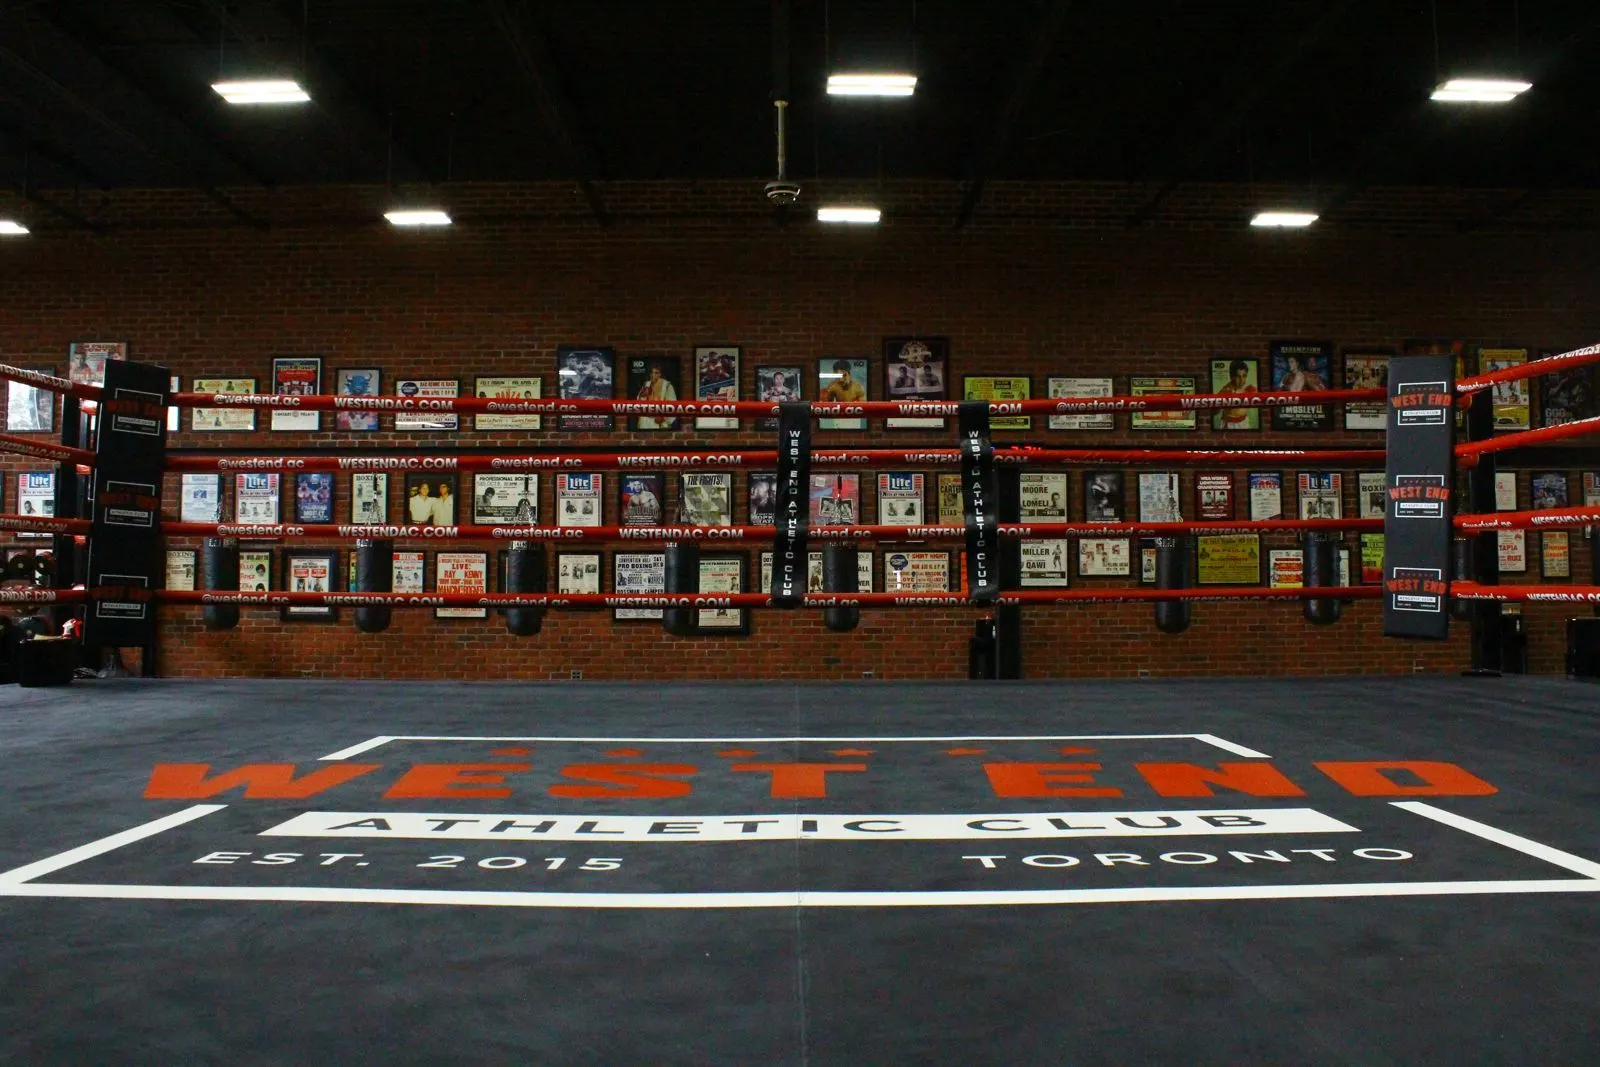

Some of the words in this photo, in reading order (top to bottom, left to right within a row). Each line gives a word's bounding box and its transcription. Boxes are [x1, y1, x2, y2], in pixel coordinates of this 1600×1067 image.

[214, 394, 300, 407] @westend.ac
[334, 397, 454, 410] WESTENDAC.COM
[487, 401, 577, 412] @westend.ac
[612, 403, 736, 415] WESTENDAC.COM
[1056, 401, 1146, 412] @westend.ac
[1181, 397, 1300, 409] WESTENDAC.COM
[1390, 393, 1425, 408] WEST
[1427, 393, 1453, 408] END
[789, 430, 801, 464] WEST
[968, 429, 981, 461] WEST
[217, 458, 305, 470] @westend.ac
[338, 457, 457, 469] WESTENDAC.COM
[491, 457, 583, 469] @westend.ac
[617, 455, 742, 467] WESTENDAC.COM
[569, 477, 589, 489] Lite
[687, 475, 699, 486] THE
[699, 475, 724, 486] FIGHTS!
[789, 470, 798, 495] END
[891, 478, 911, 489] Lite
[1022, 486, 1048, 494] MOORE
[1388, 486, 1422, 500] WEST
[1425, 486, 1451, 501] END
[1022, 500, 1049, 508] LOMELI
[972, 481, 987, 548] ATHLETIC
[216, 524, 305, 537] @westend.ac
[338, 524, 458, 538] WESTENDAC.COM
[492, 525, 584, 539] @westend.ac
[619, 526, 744, 540] WESTENDAC.COM
[787, 500, 797, 560] ATHLETIC
[1022, 548, 1050, 556] MILLER
[976, 552, 988, 586] CLUB
[1026, 561, 1046, 569] QAWI
[782, 565, 793, 596] CLUB
[1386, 579, 1419, 592] WEST
[1423, 580, 1447, 594] END
[143, 763, 867, 799] WEST
[982, 761, 1499, 798] END
[325, 817, 905, 835] ATHLETIC
[966, 815, 1267, 832] CLUB
[192, 851, 370, 867] EST.
[416, 855, 623, 871] 2015
[962, 847, 1413, 869] TORONTO
